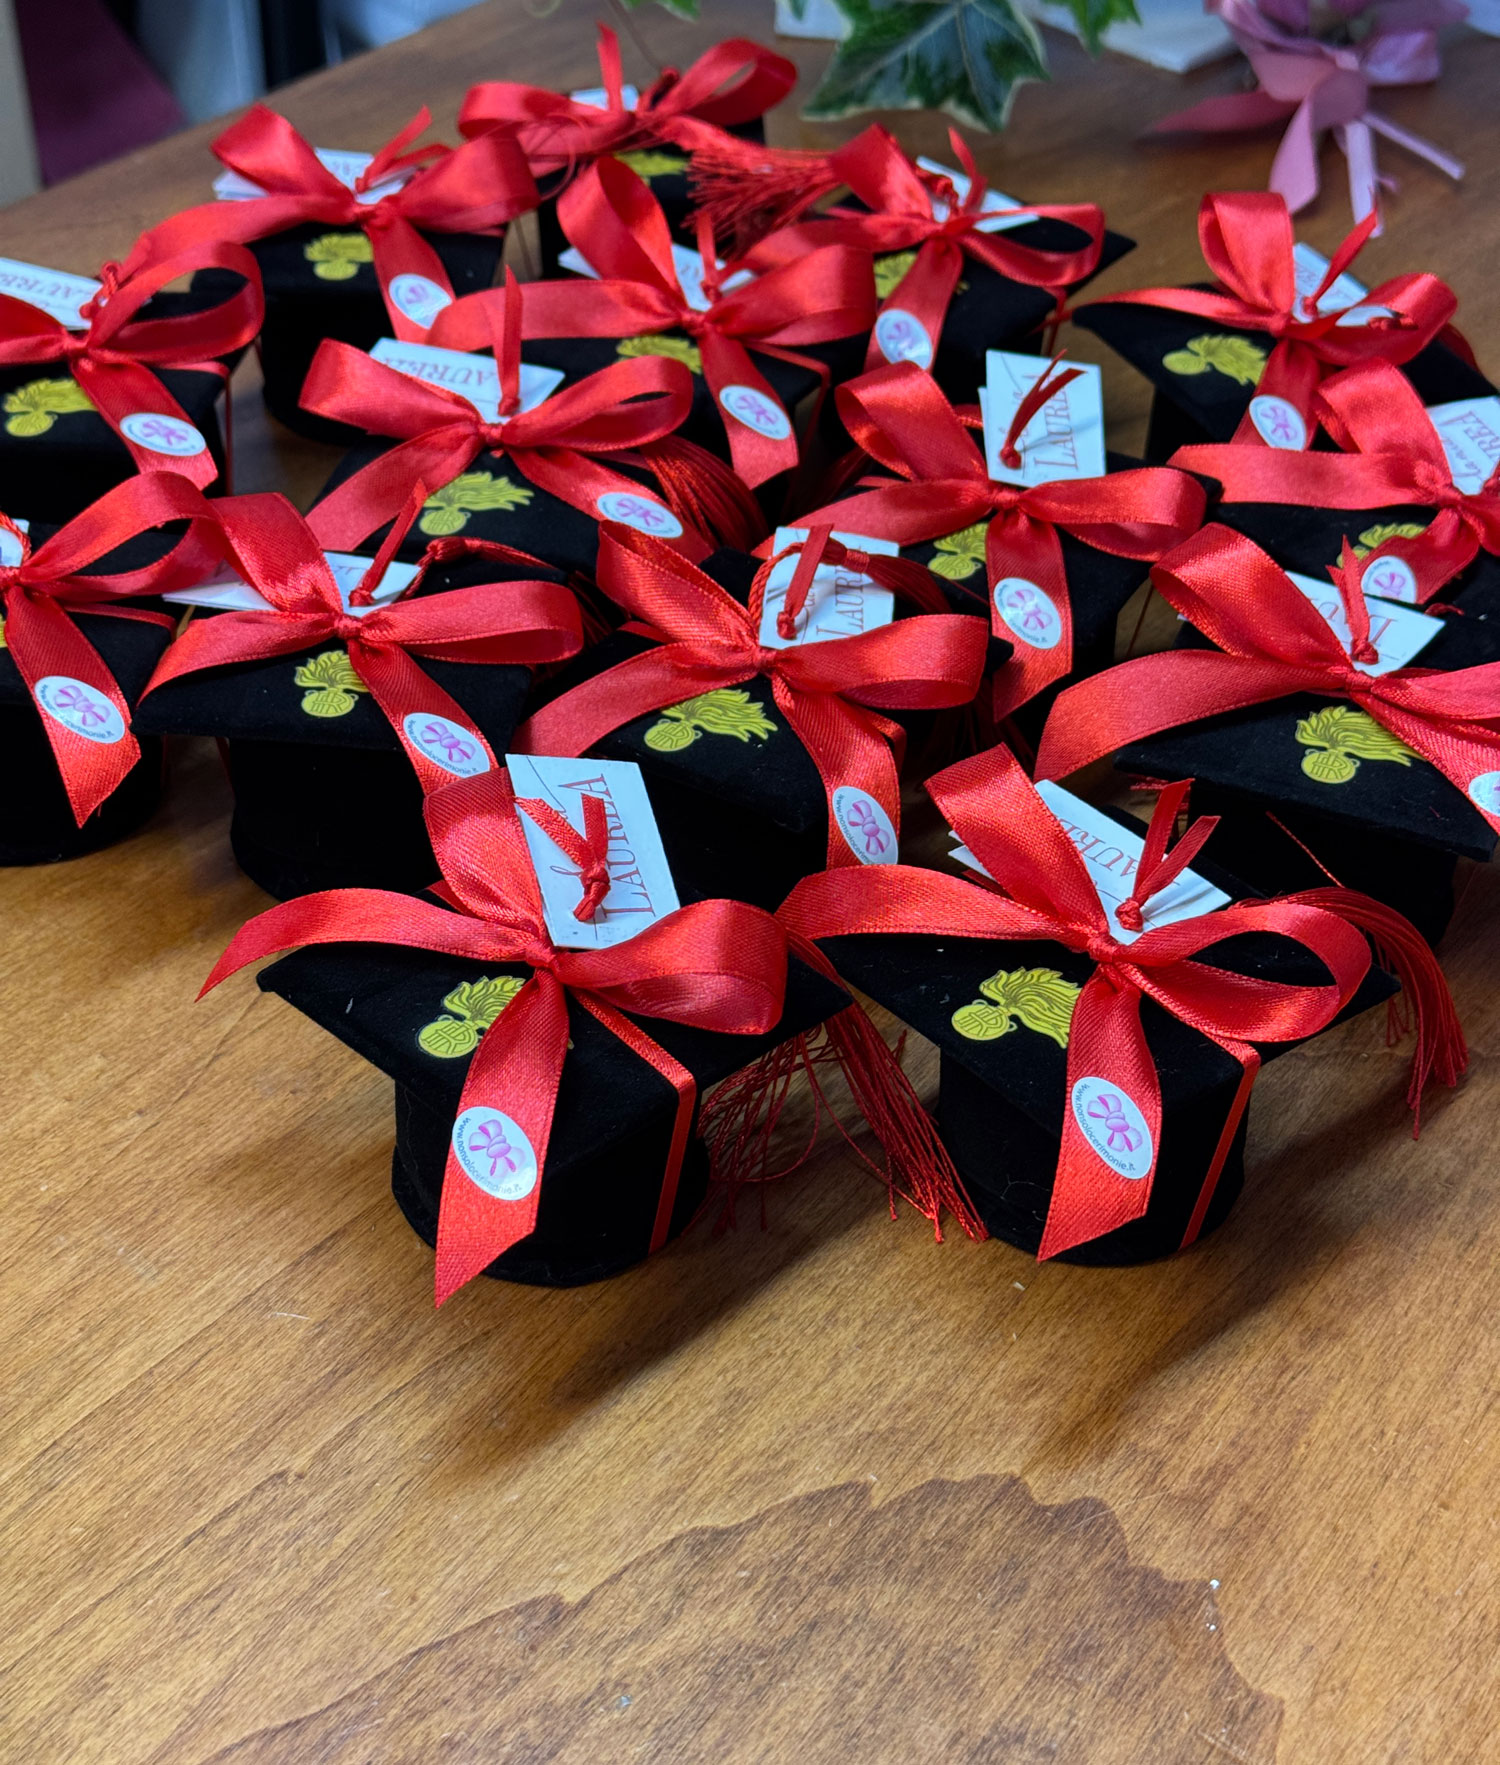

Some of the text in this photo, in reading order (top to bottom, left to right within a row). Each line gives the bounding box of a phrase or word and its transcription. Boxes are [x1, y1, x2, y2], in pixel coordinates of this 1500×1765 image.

[385, 357, 496, 387] AURE
[816, 564, 866, 635] LAUR
[1075, 1083, 1137, 1172] www.nonsolocerimonie.it
